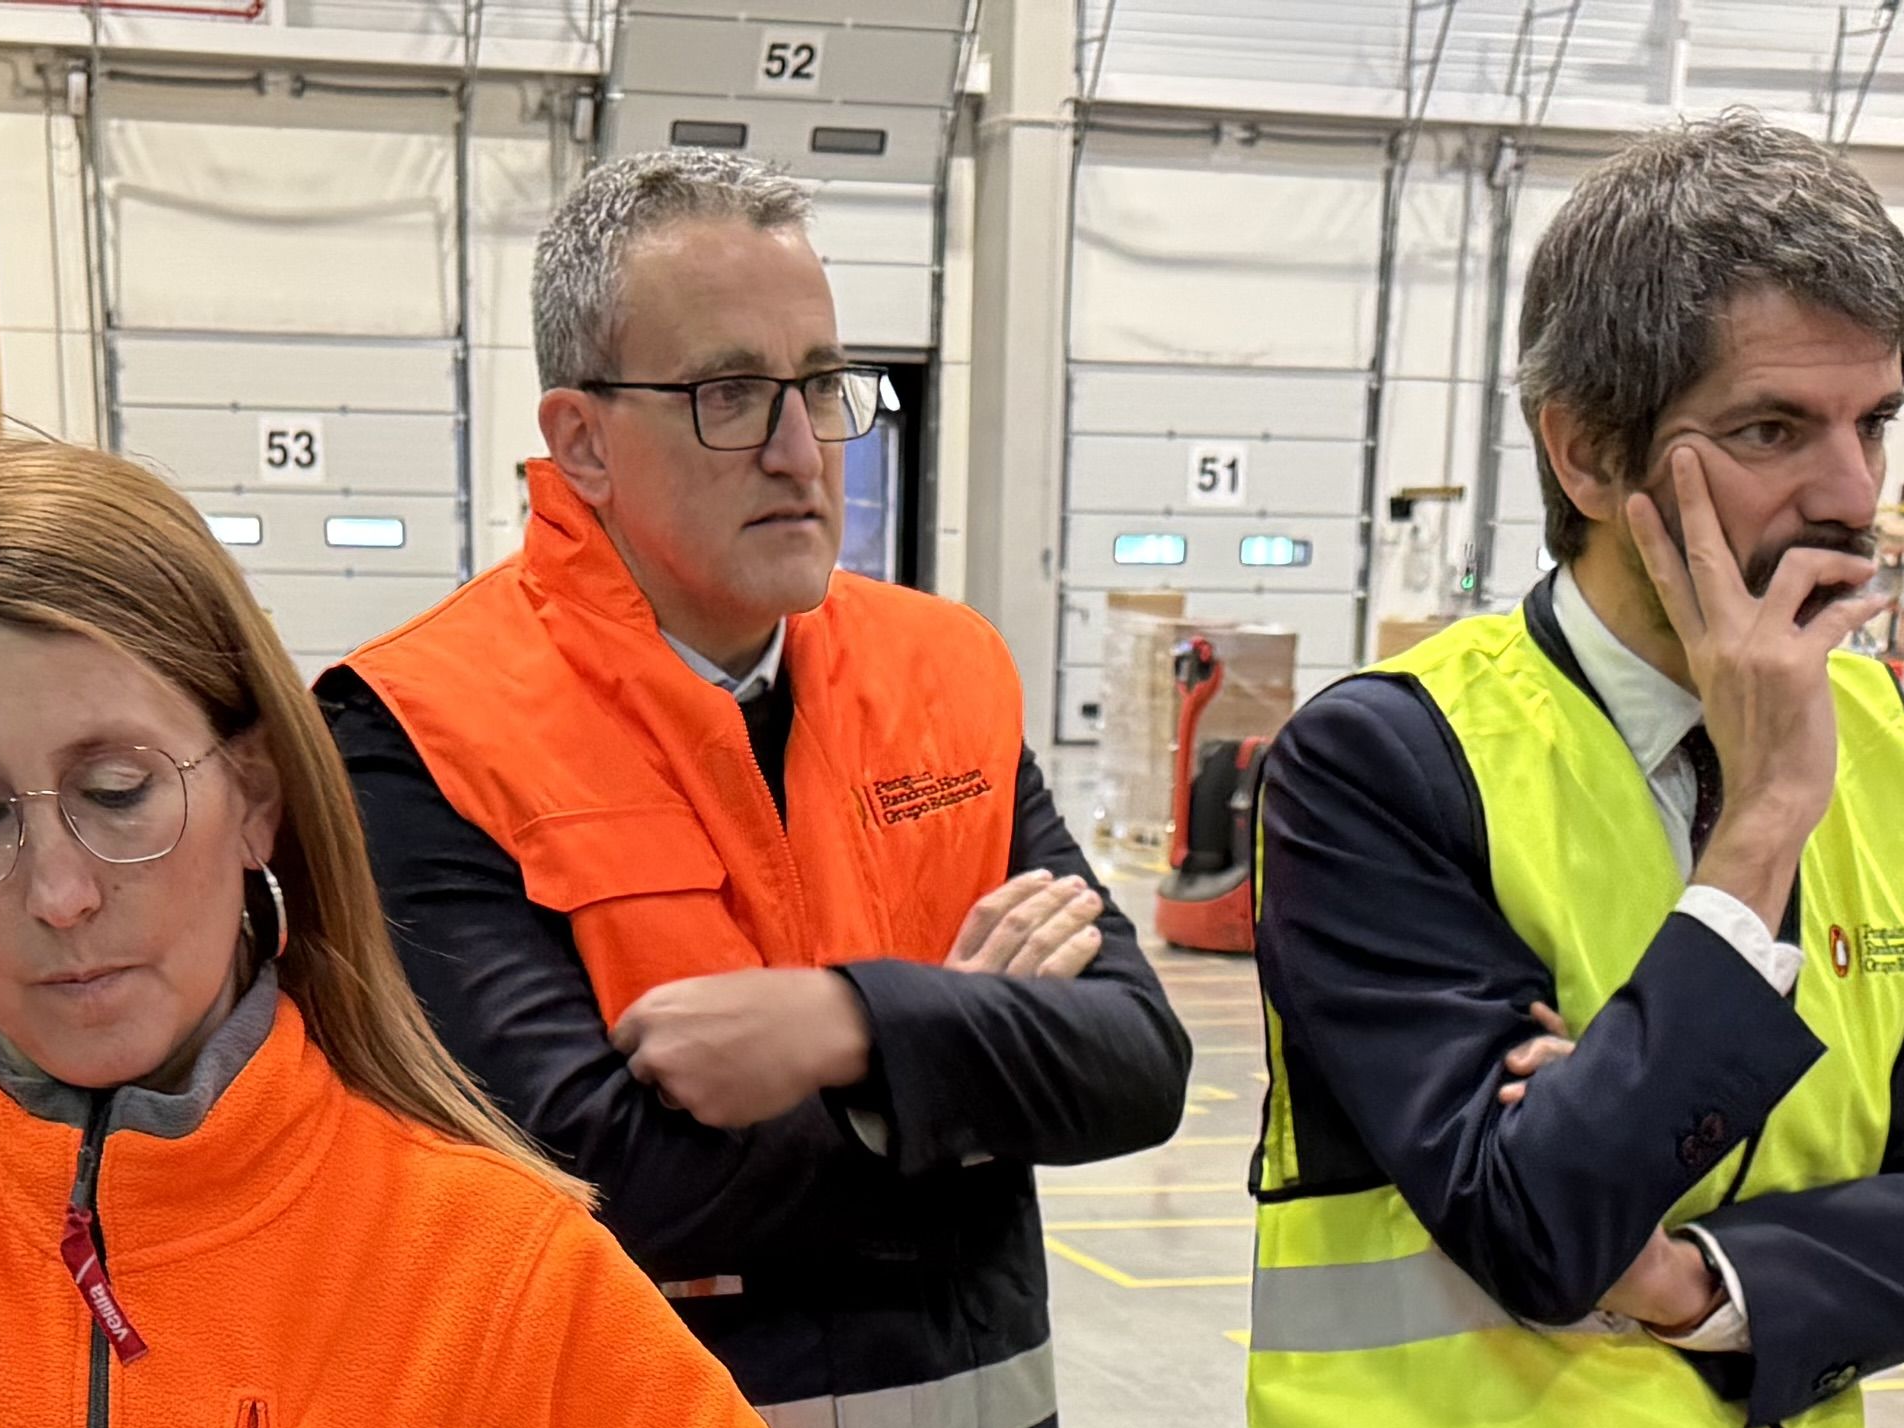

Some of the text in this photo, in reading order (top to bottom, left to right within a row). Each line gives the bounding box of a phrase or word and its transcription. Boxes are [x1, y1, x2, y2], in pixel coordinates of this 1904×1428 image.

[764, 43, 816, 79] 52
[267, 430, 316, 469] 53
[1197, 457, 1239, 494] 51
